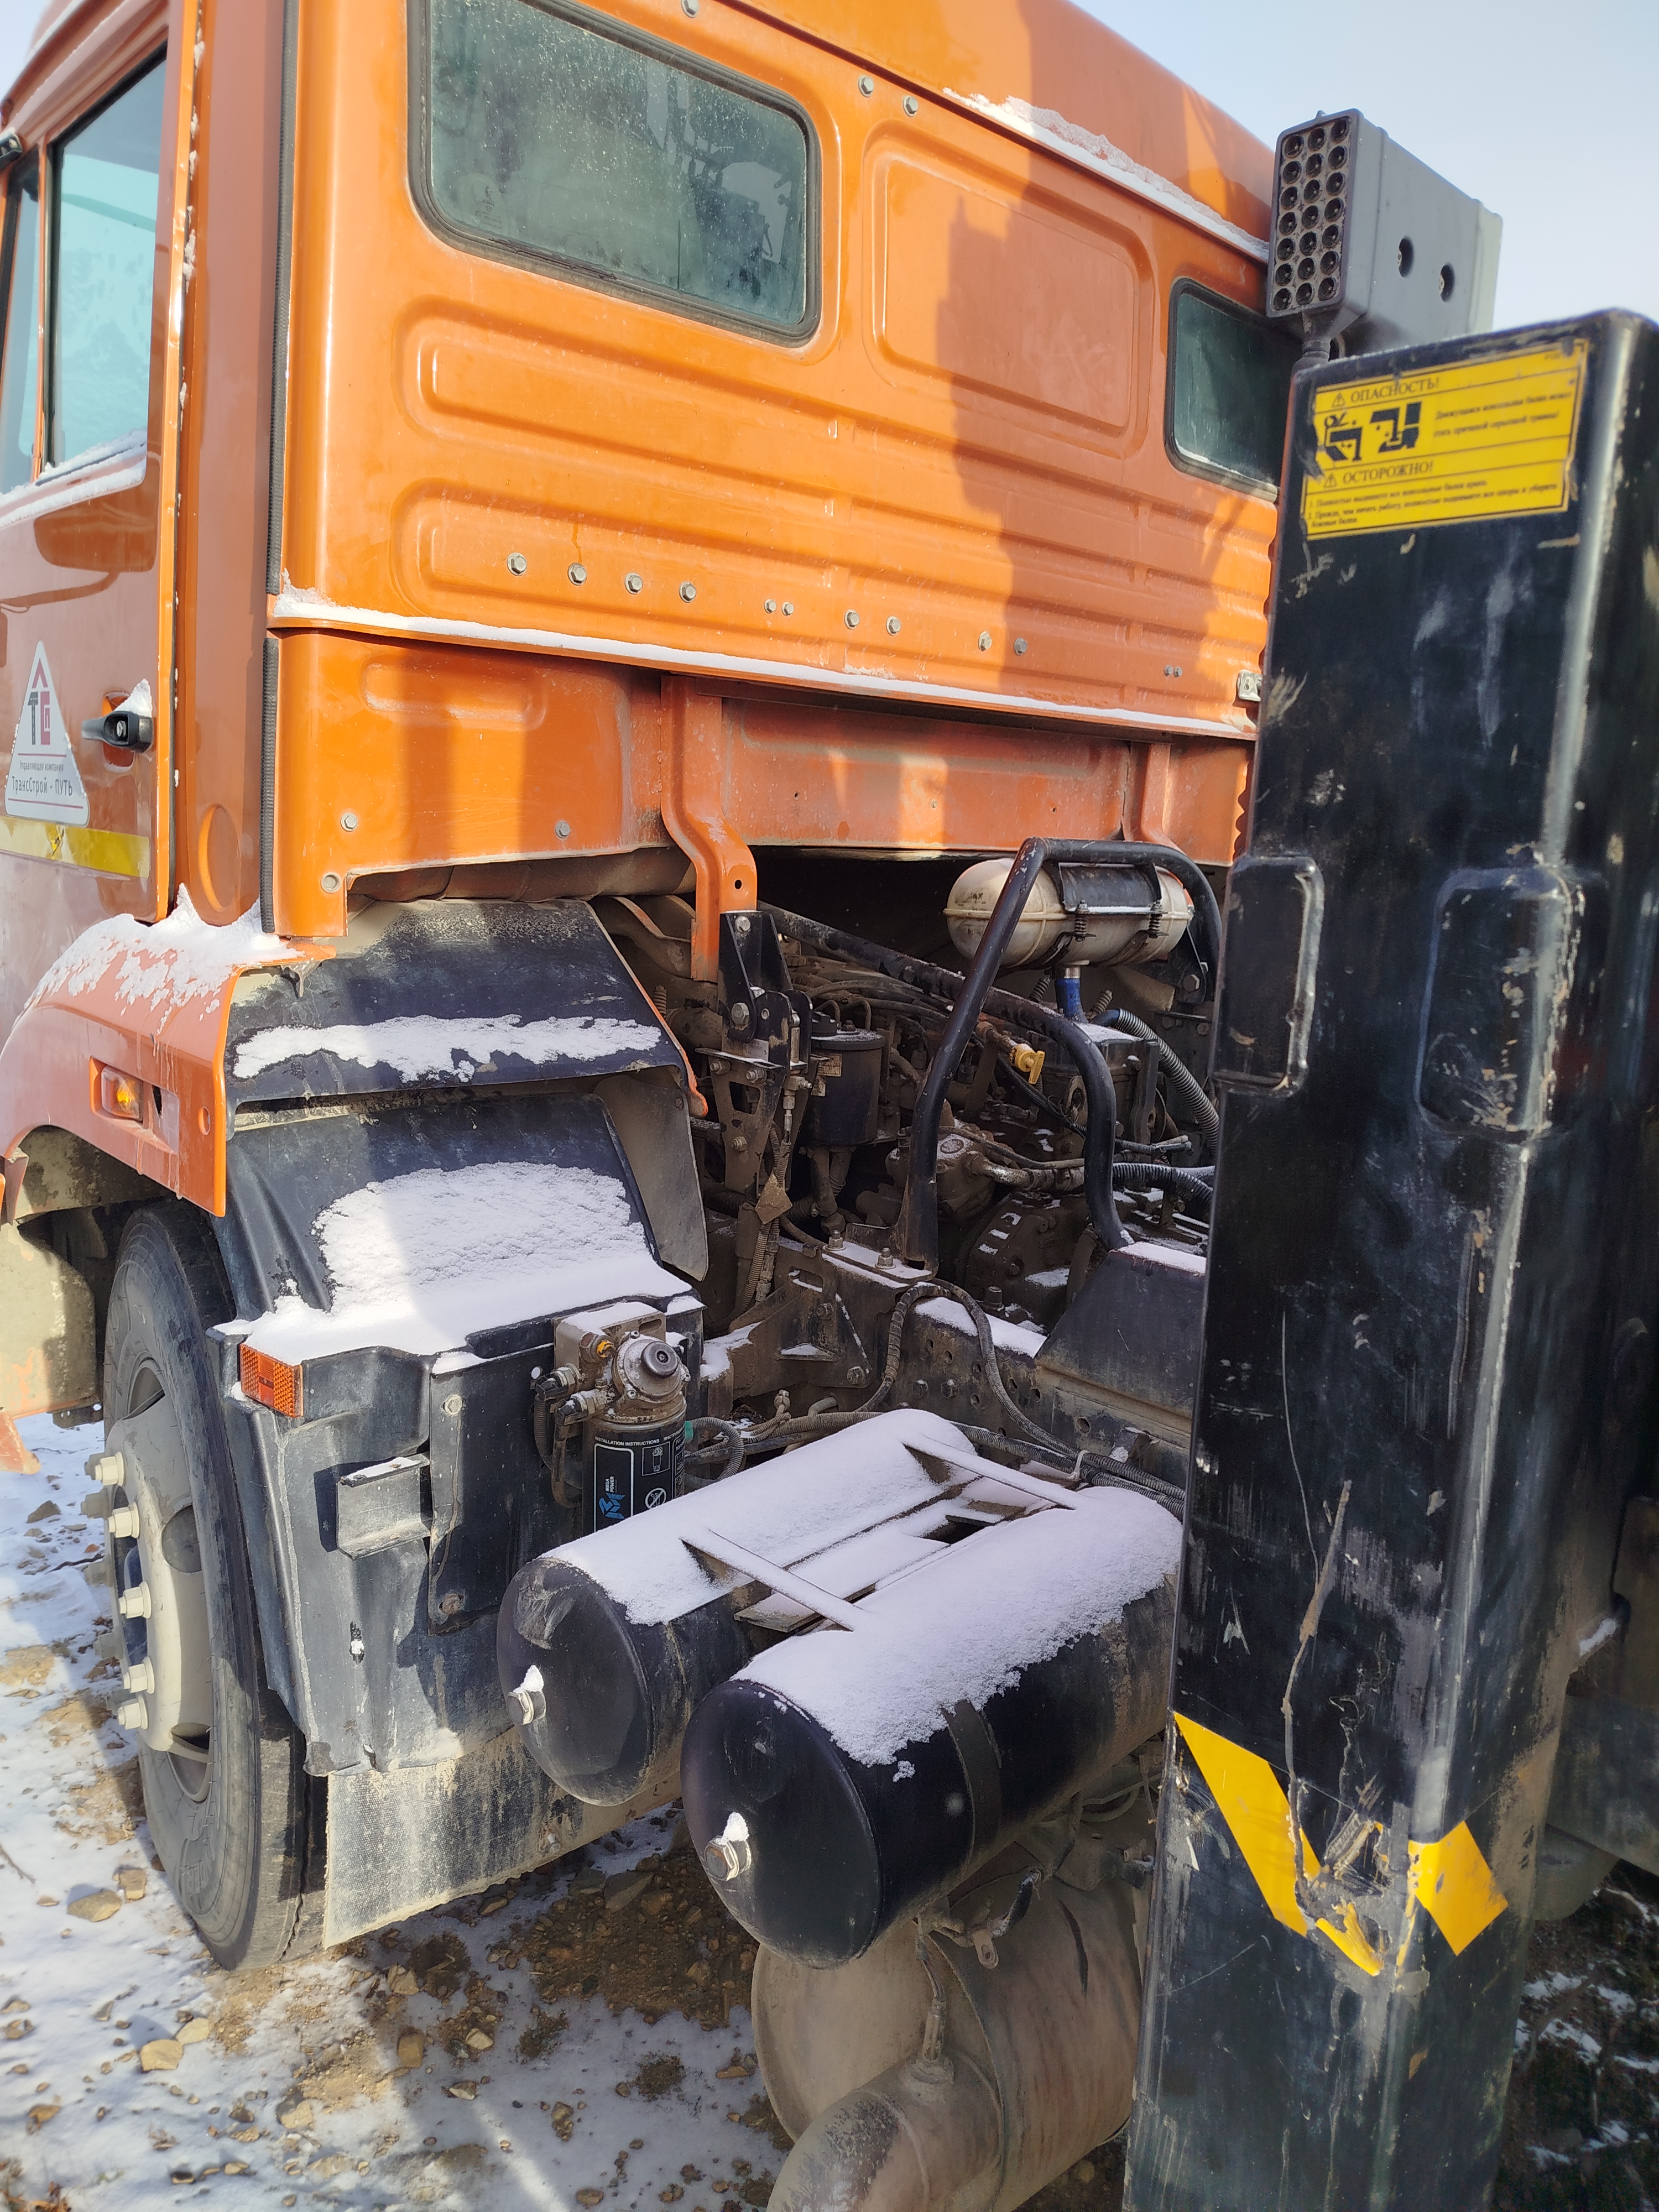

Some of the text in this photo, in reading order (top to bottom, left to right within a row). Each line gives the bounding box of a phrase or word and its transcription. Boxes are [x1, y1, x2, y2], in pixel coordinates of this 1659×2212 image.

[1350, 377, 1439, 403] ОПАСНОСТЬ!
[1343, 461, 1433, 484] ОСТОРОЖНО!
[12, 776, 48, 797] ТрансСтрой
[55, 778, 73, 796] ПУТЬ
[594, 1436, 660, 1447] INSTALLATION INSTRUCTIONS
